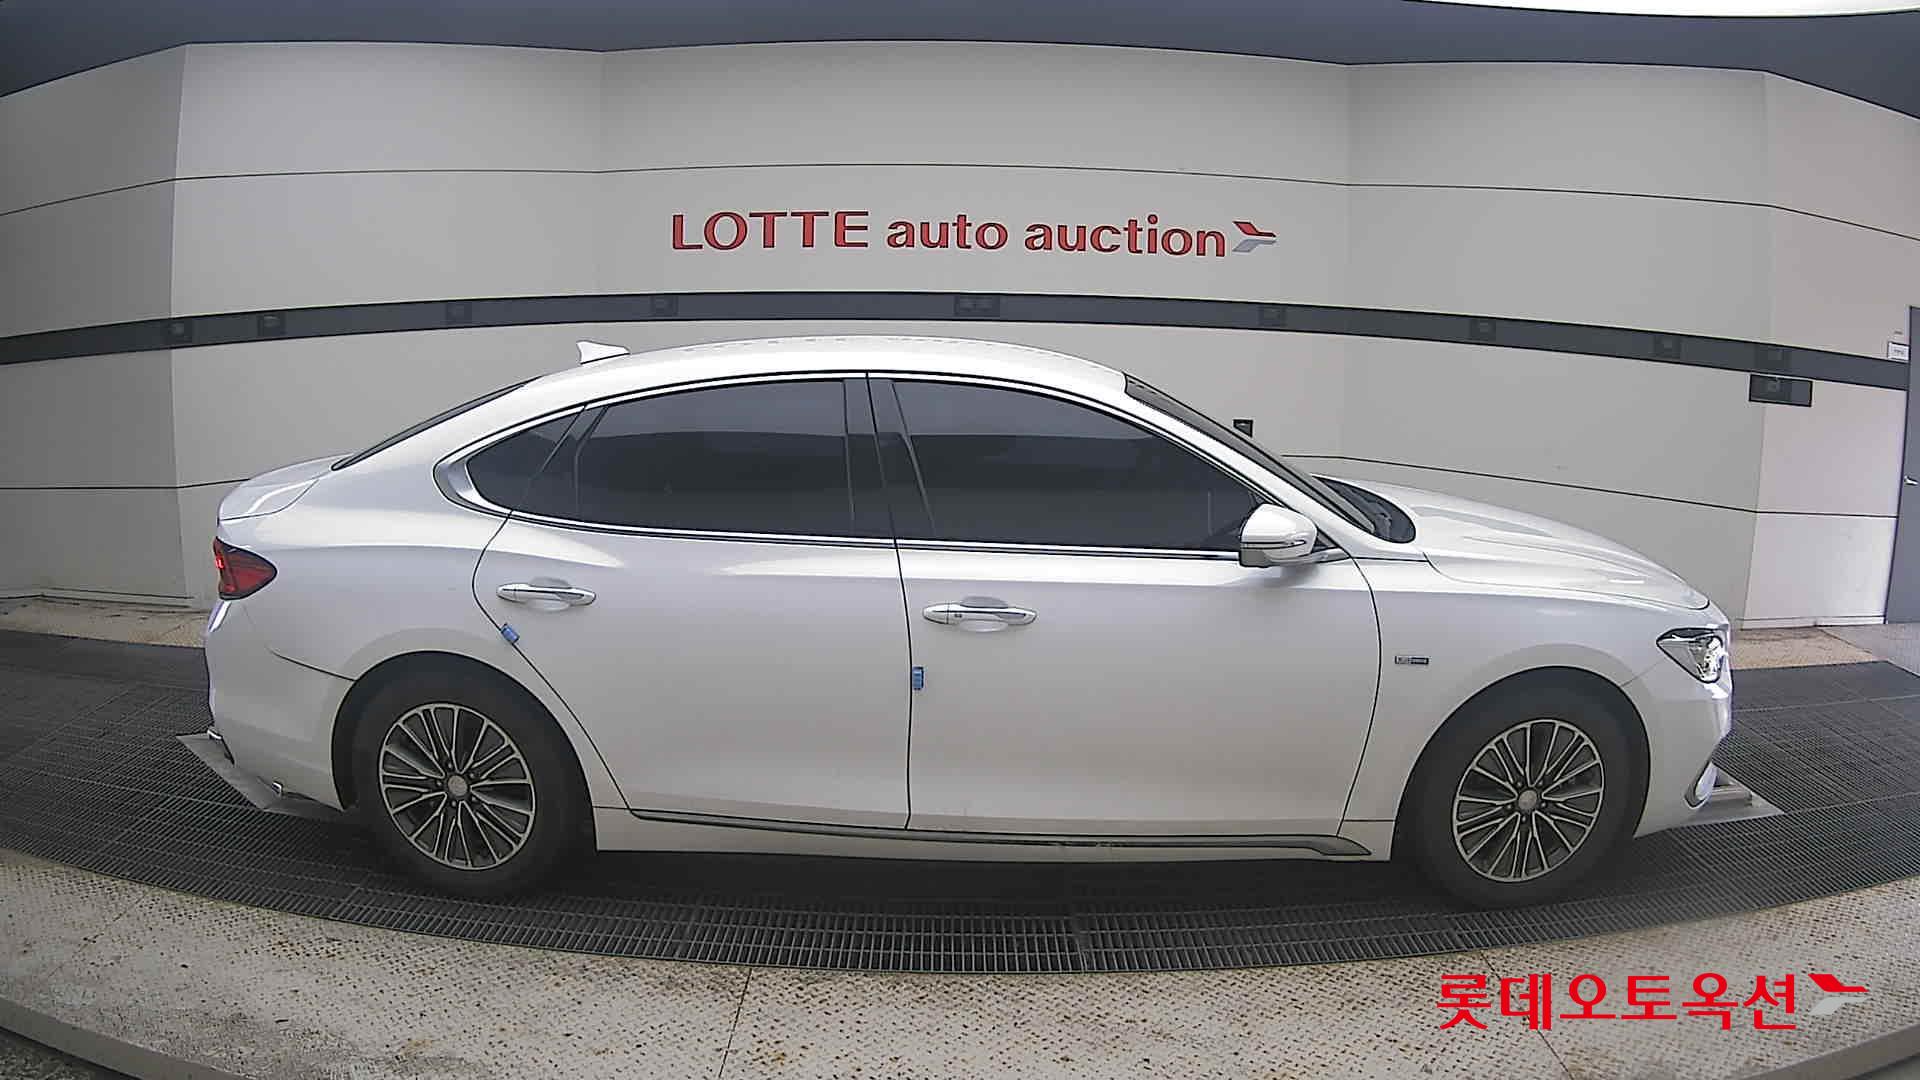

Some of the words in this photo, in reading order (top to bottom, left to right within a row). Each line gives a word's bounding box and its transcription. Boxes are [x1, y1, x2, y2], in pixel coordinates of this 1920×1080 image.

[672, 211, 869, 250] LOTTE
[886, 214, 1008, 249] auto
[1024, 214, 1225, 257] auction
